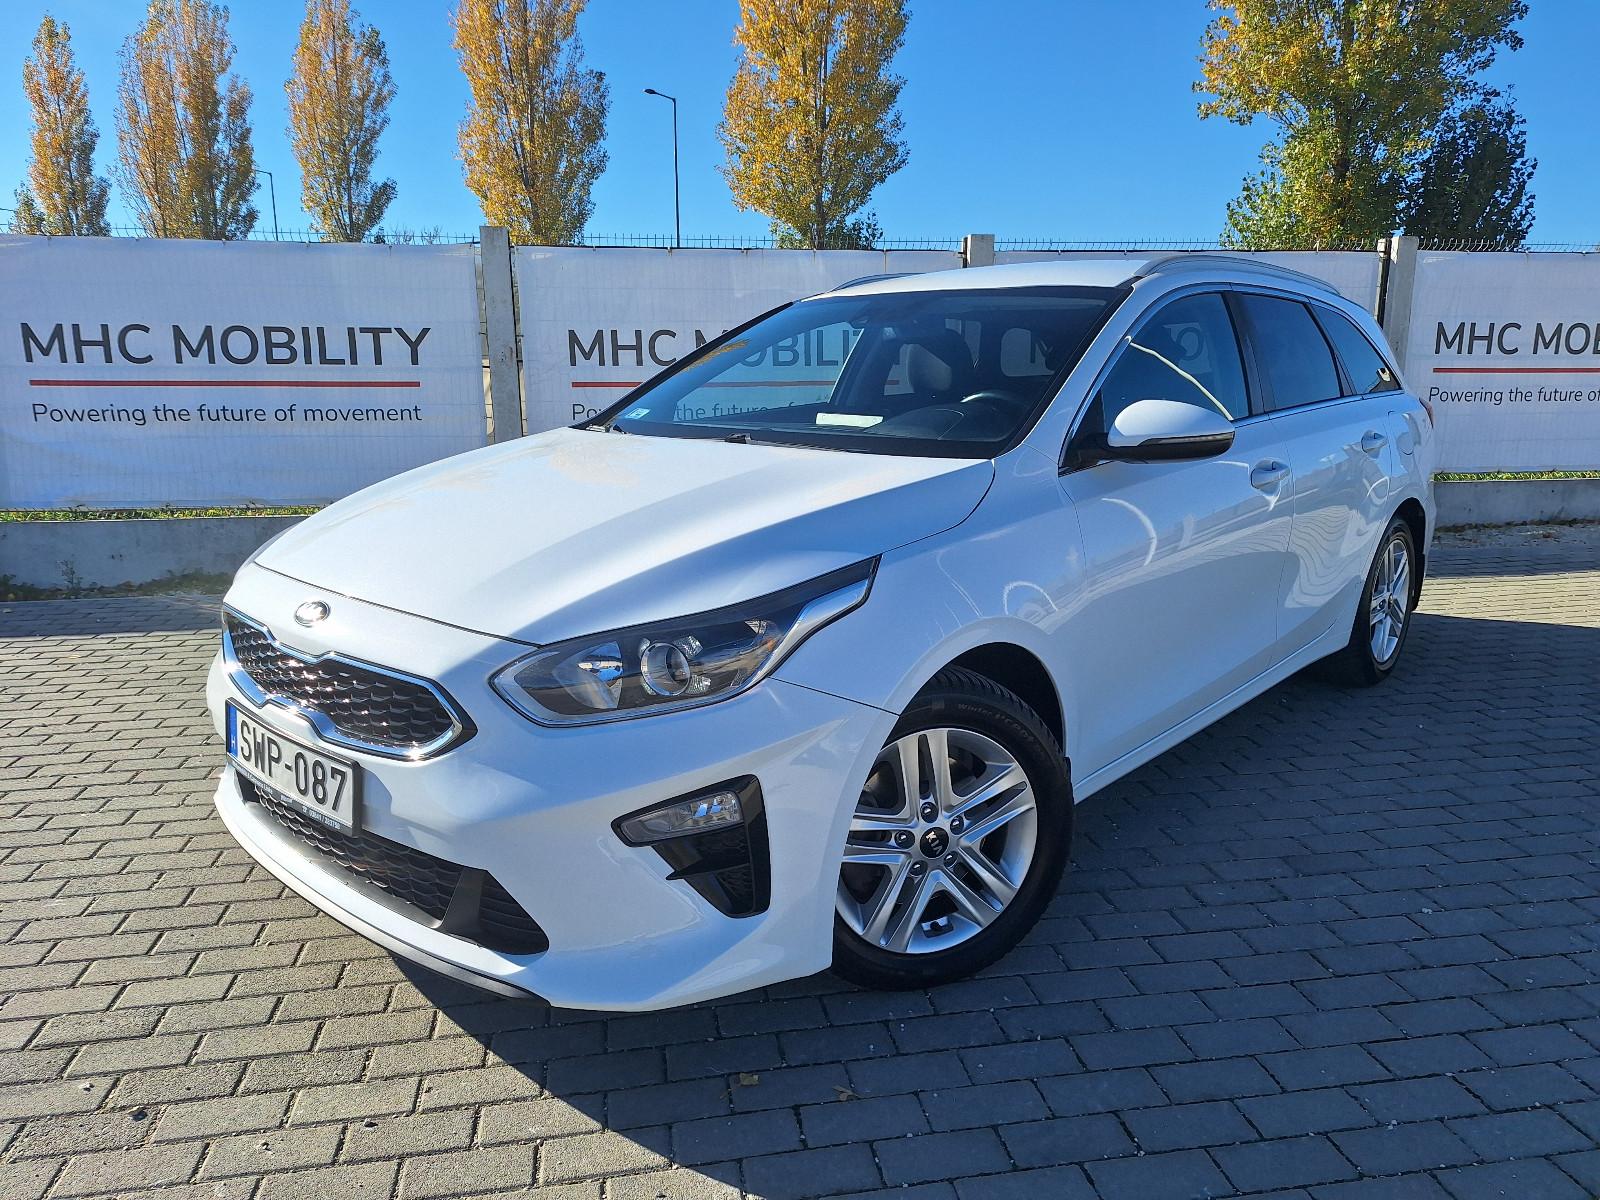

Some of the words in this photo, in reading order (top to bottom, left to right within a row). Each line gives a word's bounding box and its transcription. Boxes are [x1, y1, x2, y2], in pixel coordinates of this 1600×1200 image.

[20, 322, 153, 364] MHC
[172, 325, 432, 366] MOBILITY
[567, 329, 677, 367] MHC
[1434, 321, 1522, 355] MHC
[1532, 322, 1600, 355] MO
[1428, 386, 1503, 405] Powering
[1508, 387, 1533, 402] the
[1536, 386, 1583, 402] future
[31, 403, 146, 426] Powering
[152, 403, 192, 422] the
[198, 403, 267, 422] future
[273, 403, 298, 423] of
[303, 405, 423, 423] movement
[240, 719, 347, 812] SWP-087
